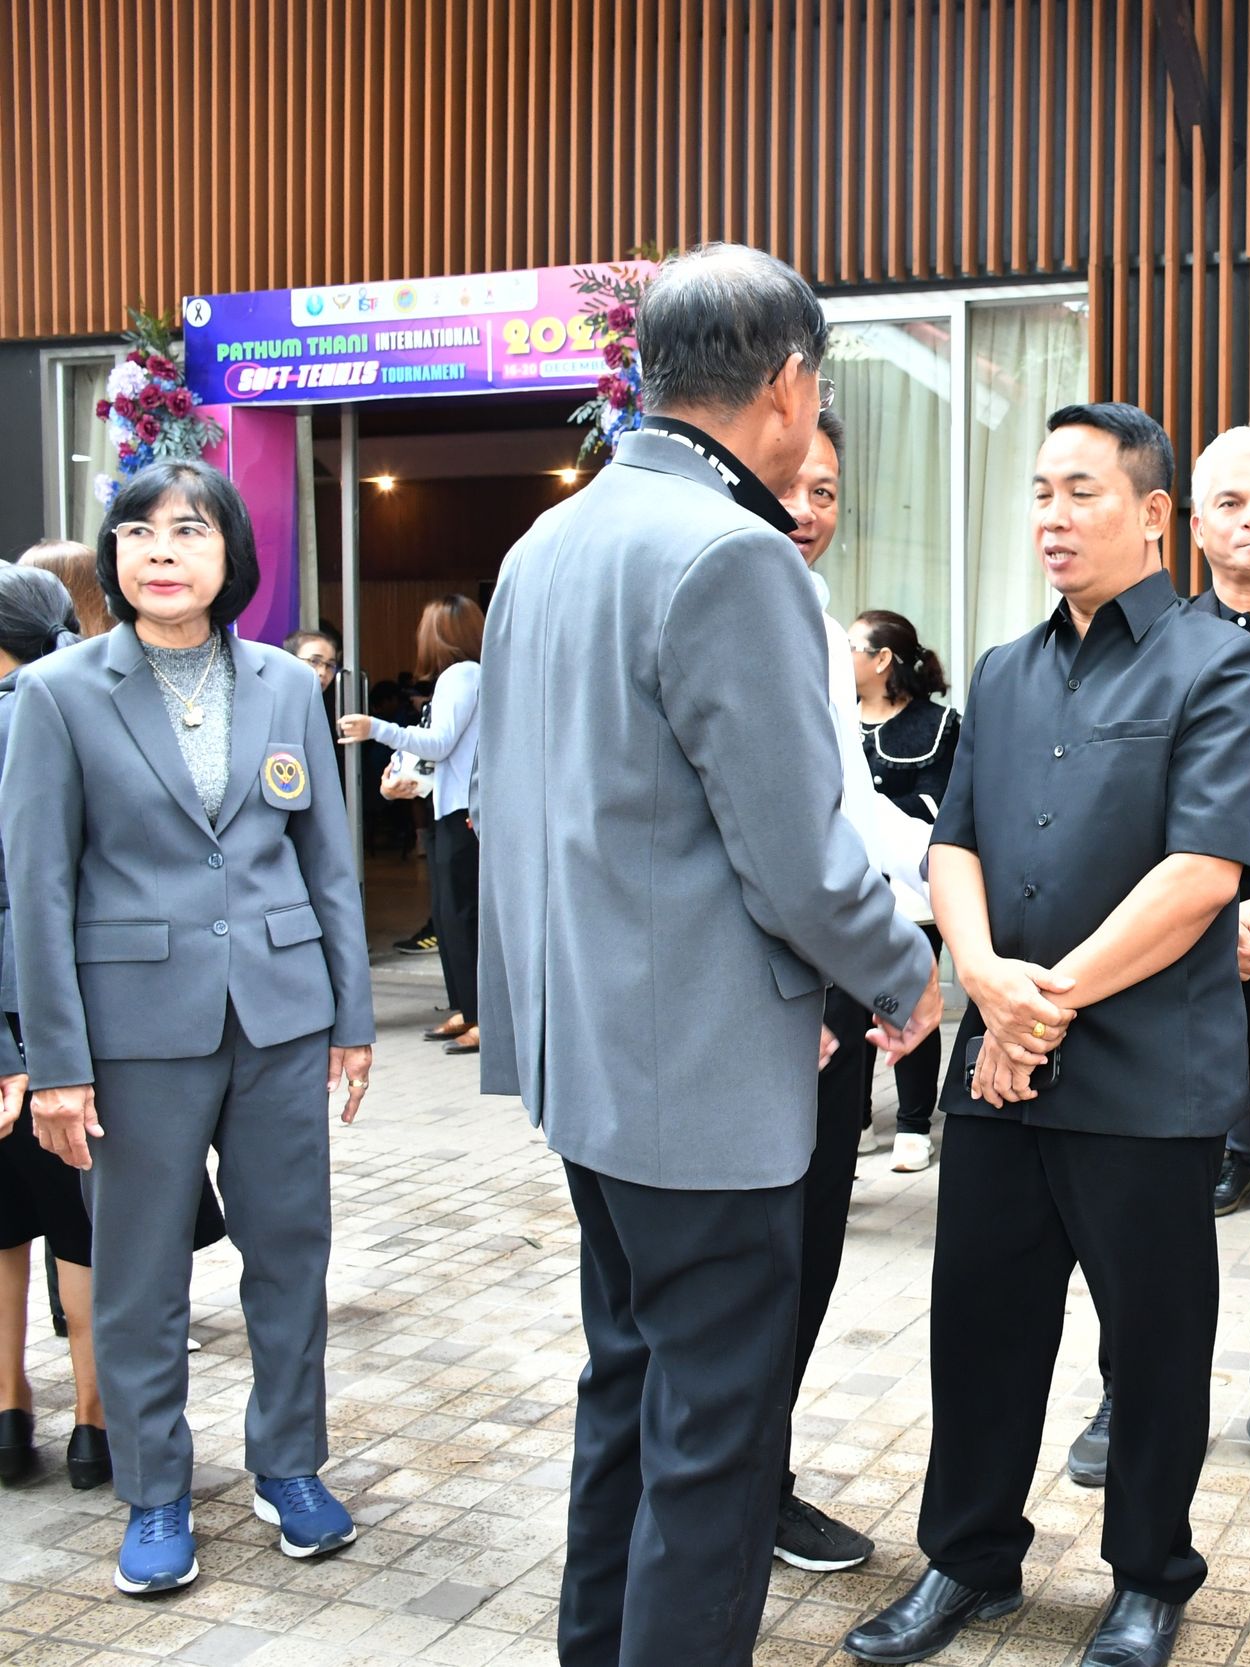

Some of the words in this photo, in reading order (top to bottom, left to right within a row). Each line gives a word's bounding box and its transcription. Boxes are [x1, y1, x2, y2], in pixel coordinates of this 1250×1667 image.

[217, 338, 302, 362] PATHUM
[307, 334, 368, 355] THANI
[375, 326, 481, 351] INTERNATIONAL
[238, 366, 293, 392] SOFT
[297, 361, 380, 388] TENNIS
[381, 363, 466, 383] TOURNAMENT
[544, 360, 607, 374] DECEMBE
